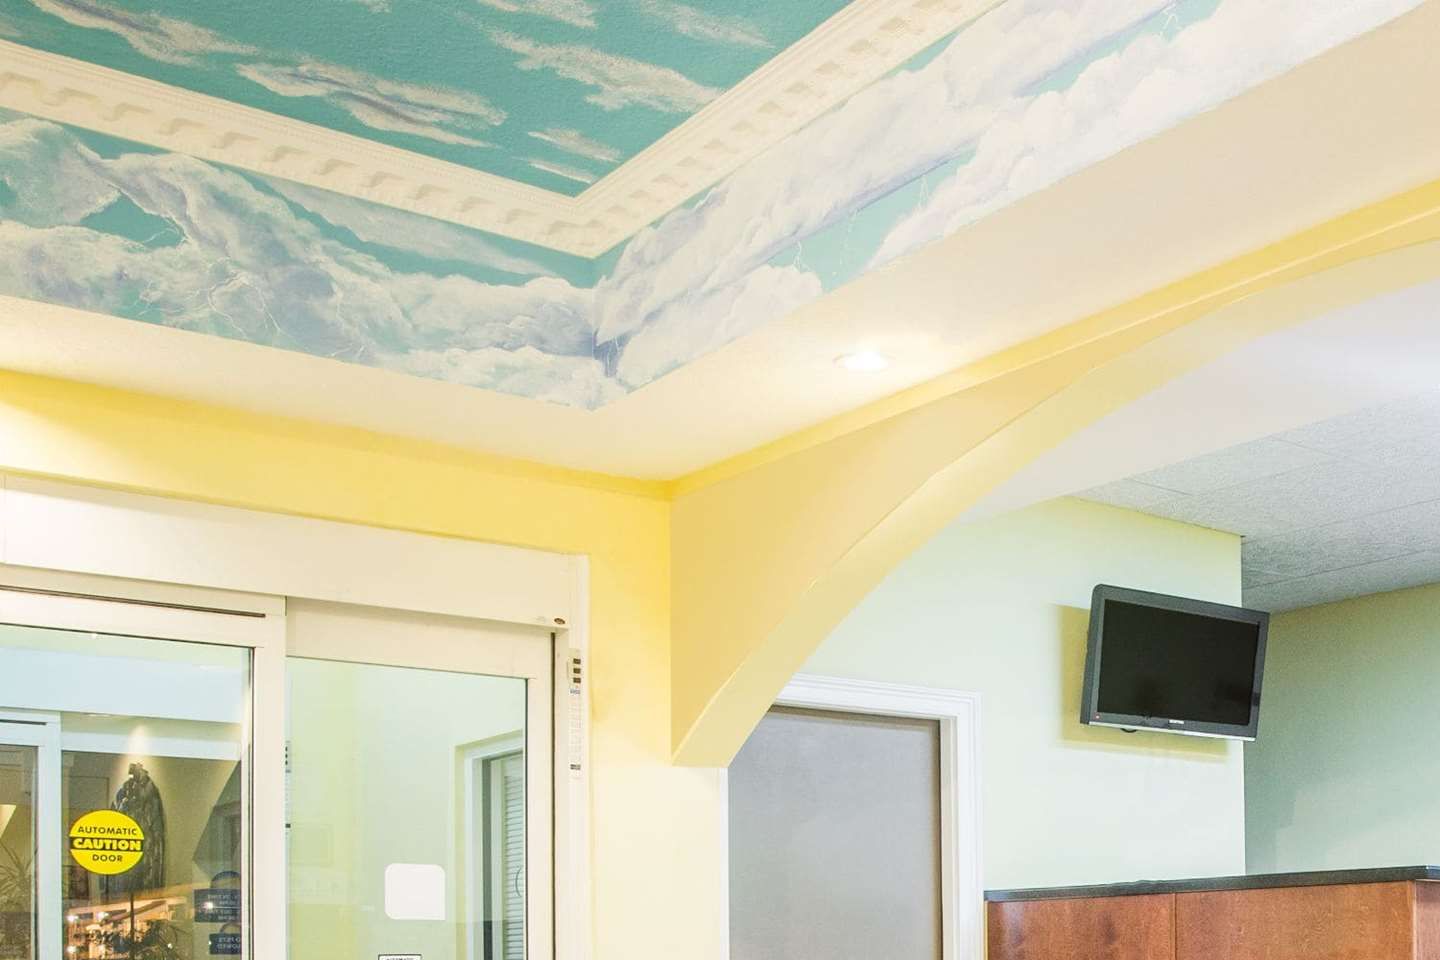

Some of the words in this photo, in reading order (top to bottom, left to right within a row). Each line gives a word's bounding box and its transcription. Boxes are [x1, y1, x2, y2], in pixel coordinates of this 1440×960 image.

[78, 826, 138, 836] AUTOMATIC
[73, 838, 141, 851] CAUTION
[92, 854, 123, 862] DOOR
